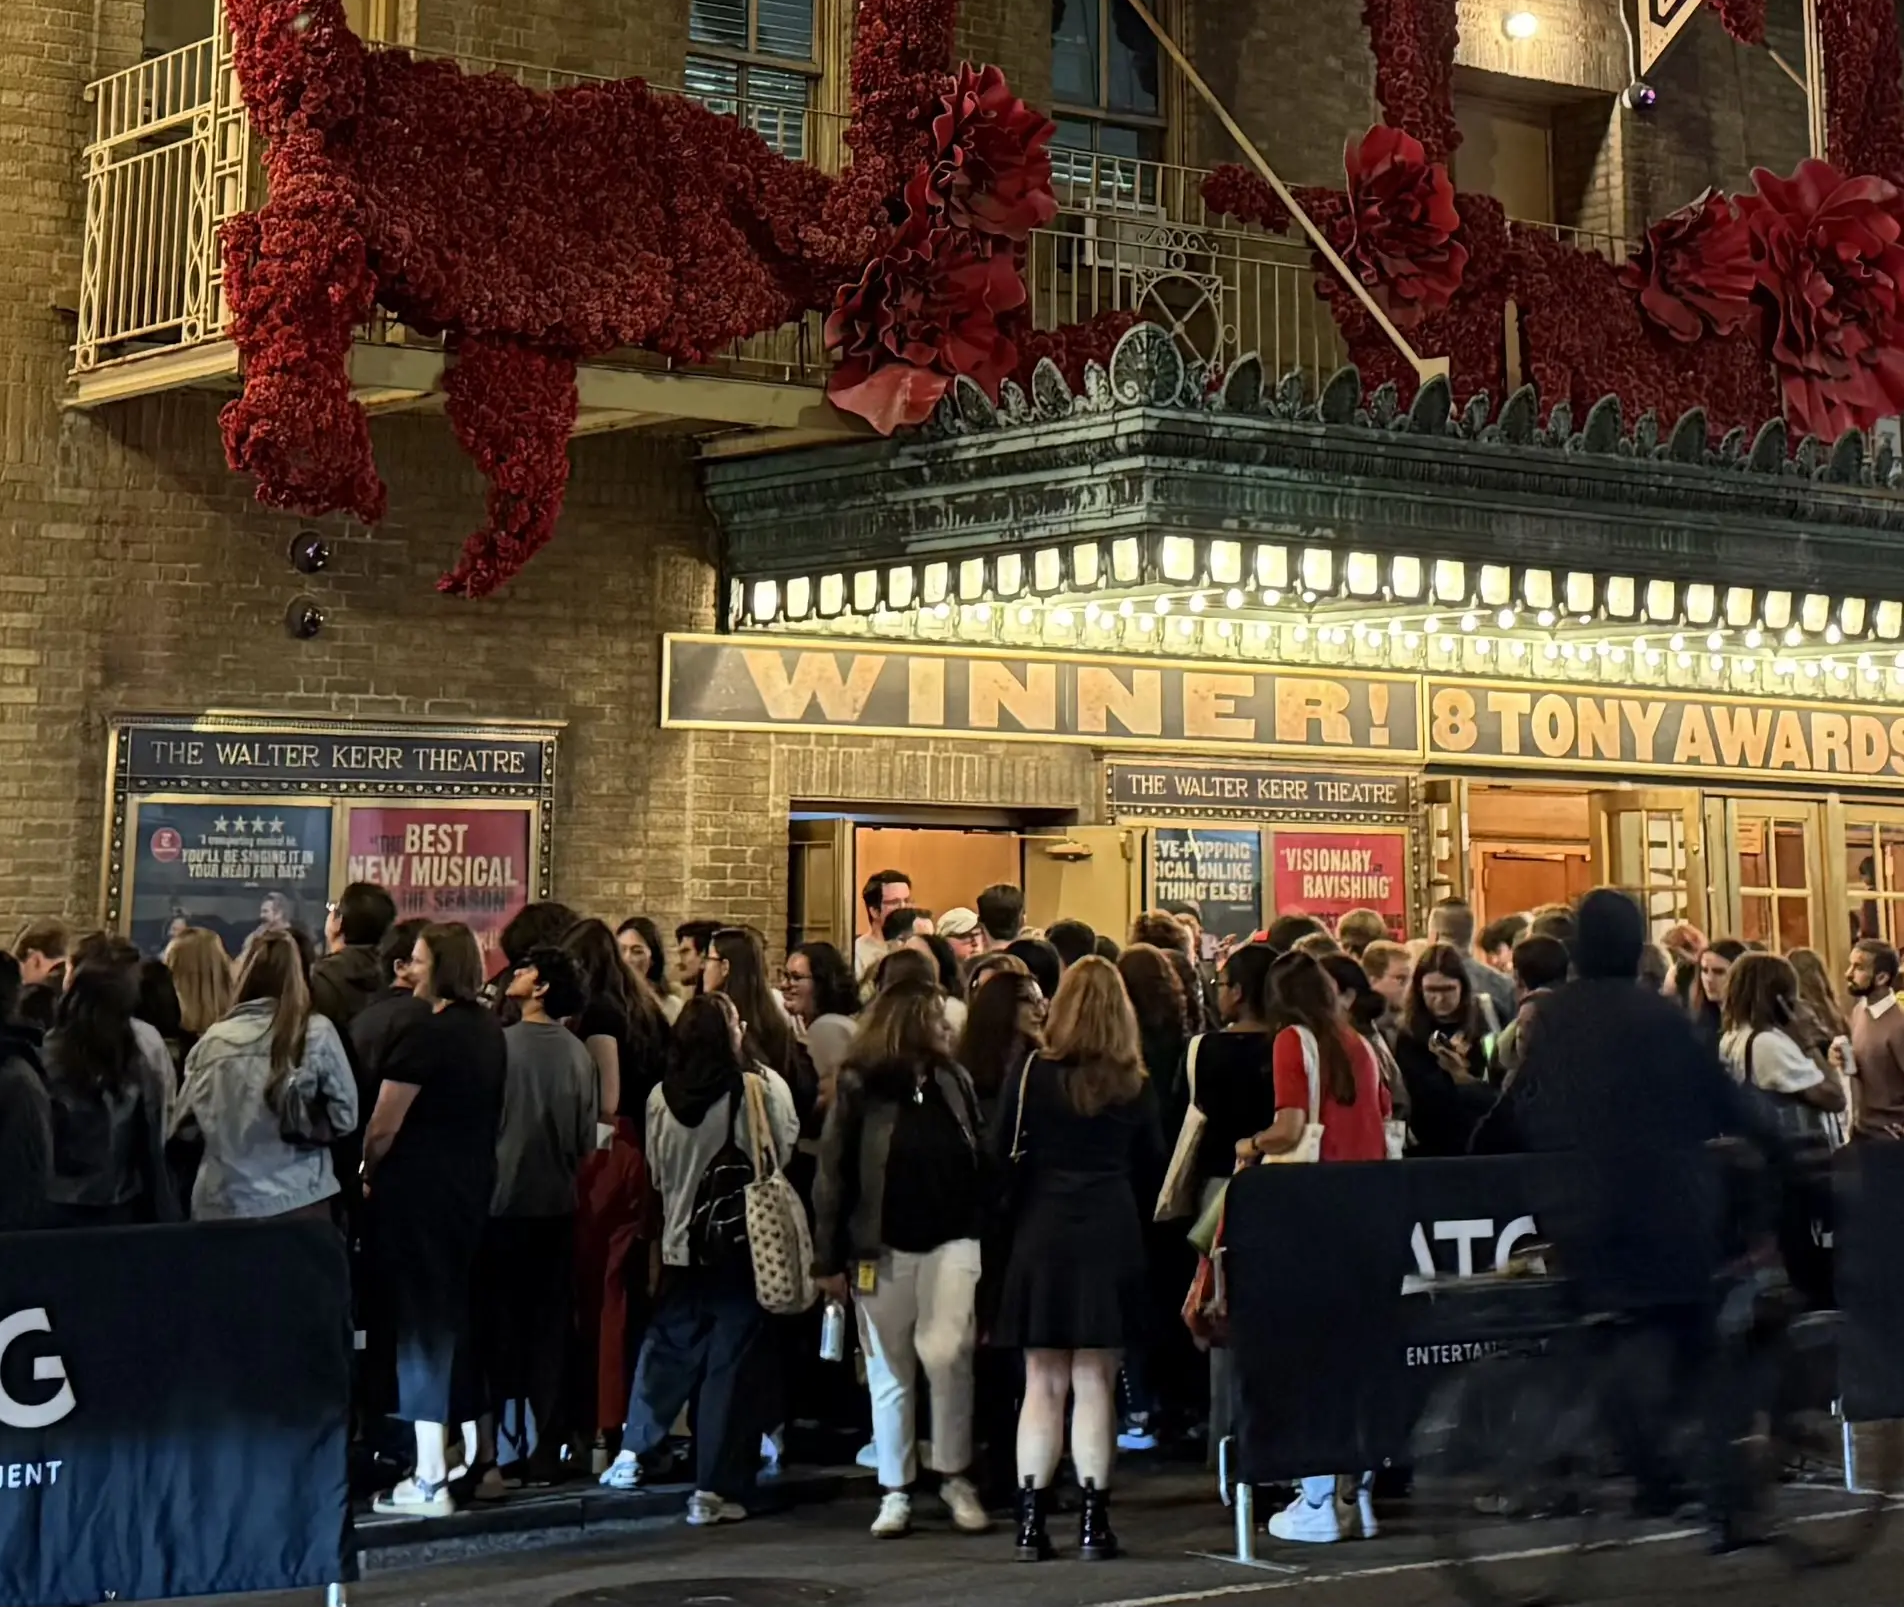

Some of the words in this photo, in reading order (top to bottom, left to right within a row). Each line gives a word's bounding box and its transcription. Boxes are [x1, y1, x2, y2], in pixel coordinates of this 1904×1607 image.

[741, 650, 1390, 745] WINNER!
[1431, 687, 1477, 752] 8
[1488, 692, 1667, 762] TONY
[150, 741, 203, 765] THE
[215, 742, 319, 768] WALTER
[332, 745, 403, 770] KERR
[413, 747, 525, 774] THEATRE
[1128, 774, 1166, 795] THE
[1174, 776, 1248, 798] WALTER
[1257, 778, 1309, 801] KERR
[1314, 781, 1398, 804] THEATRE
[405, 824, 469, 854] BEST
[348, 855, 404, 887] NEW
[411, 856, 519, 887] MUSICAL
